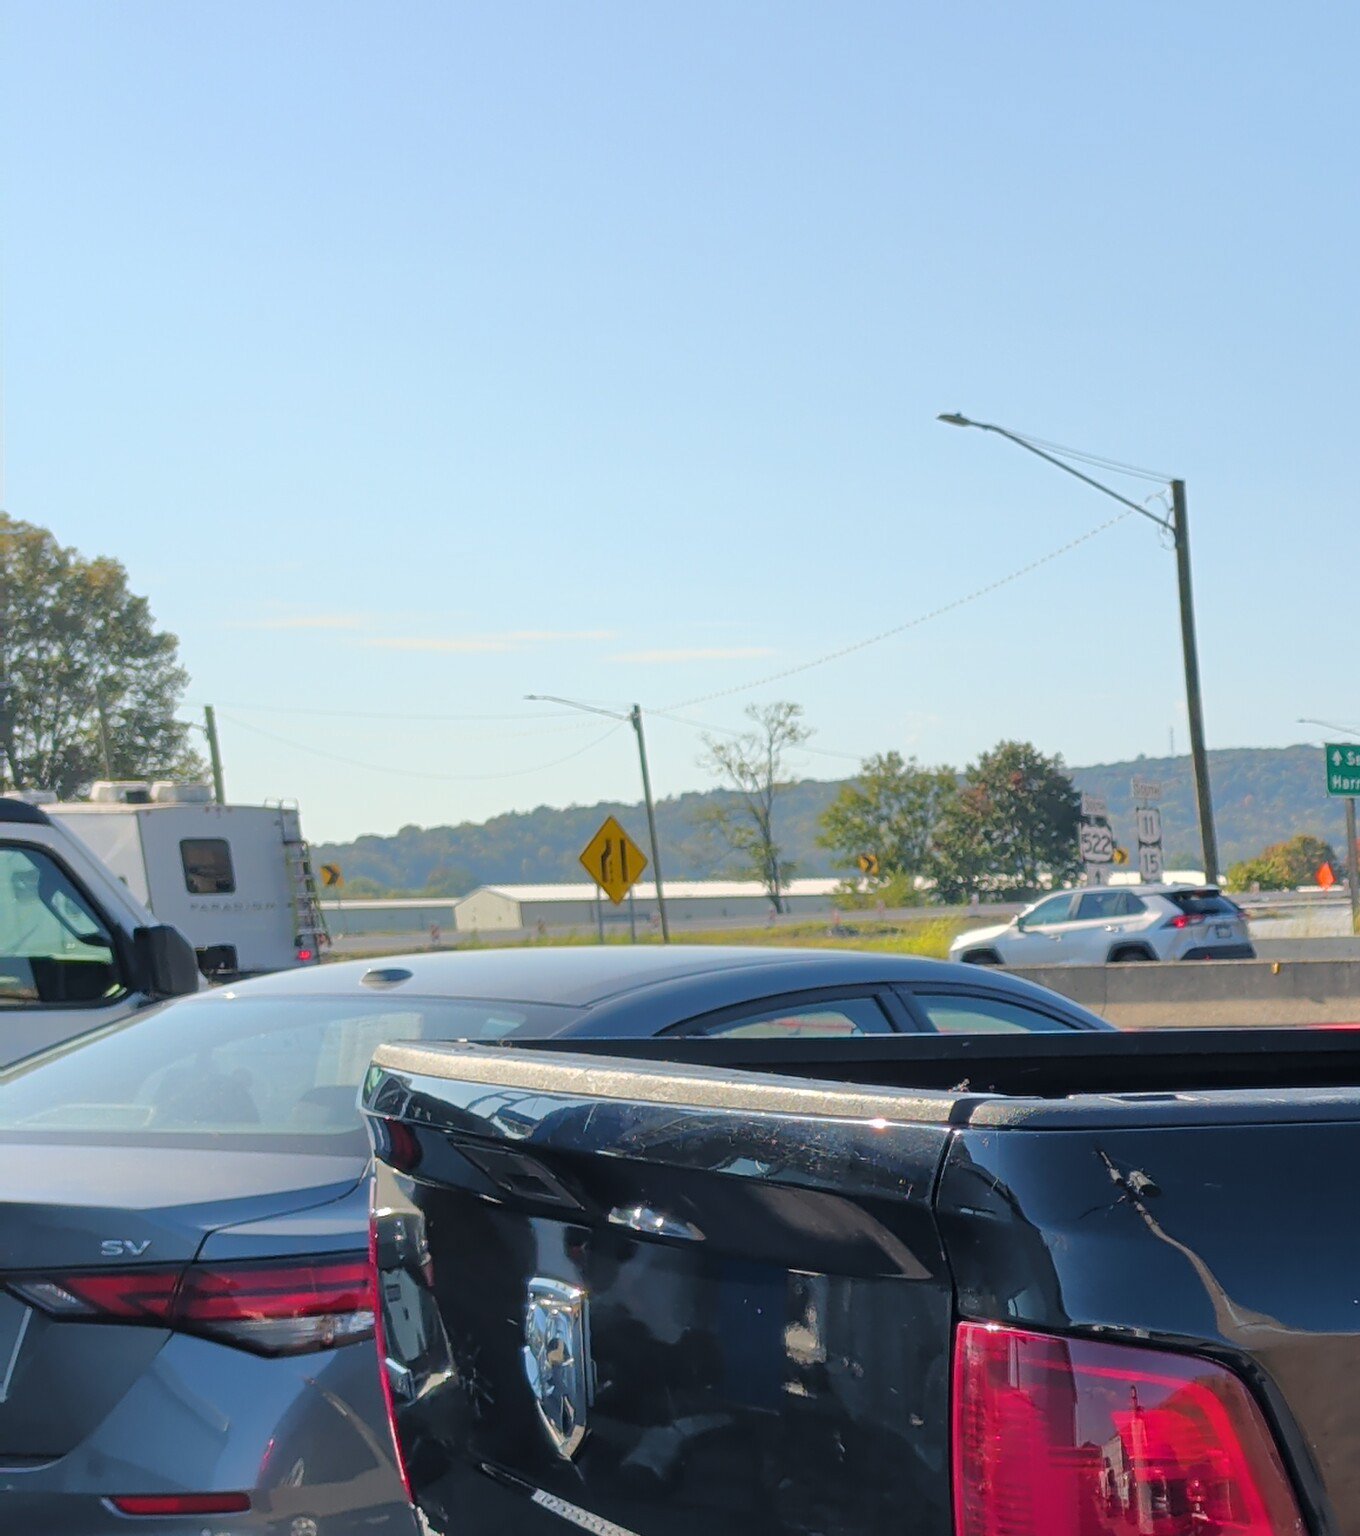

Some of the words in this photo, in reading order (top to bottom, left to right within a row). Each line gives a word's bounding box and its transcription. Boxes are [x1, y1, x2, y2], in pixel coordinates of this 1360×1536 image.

[1144, 816, 1154, 835] 11
[1081, 833, 1111, 856] 522
[1144, 854, 1159, 873] 15
[101, 1239, 151, 1256] SV
